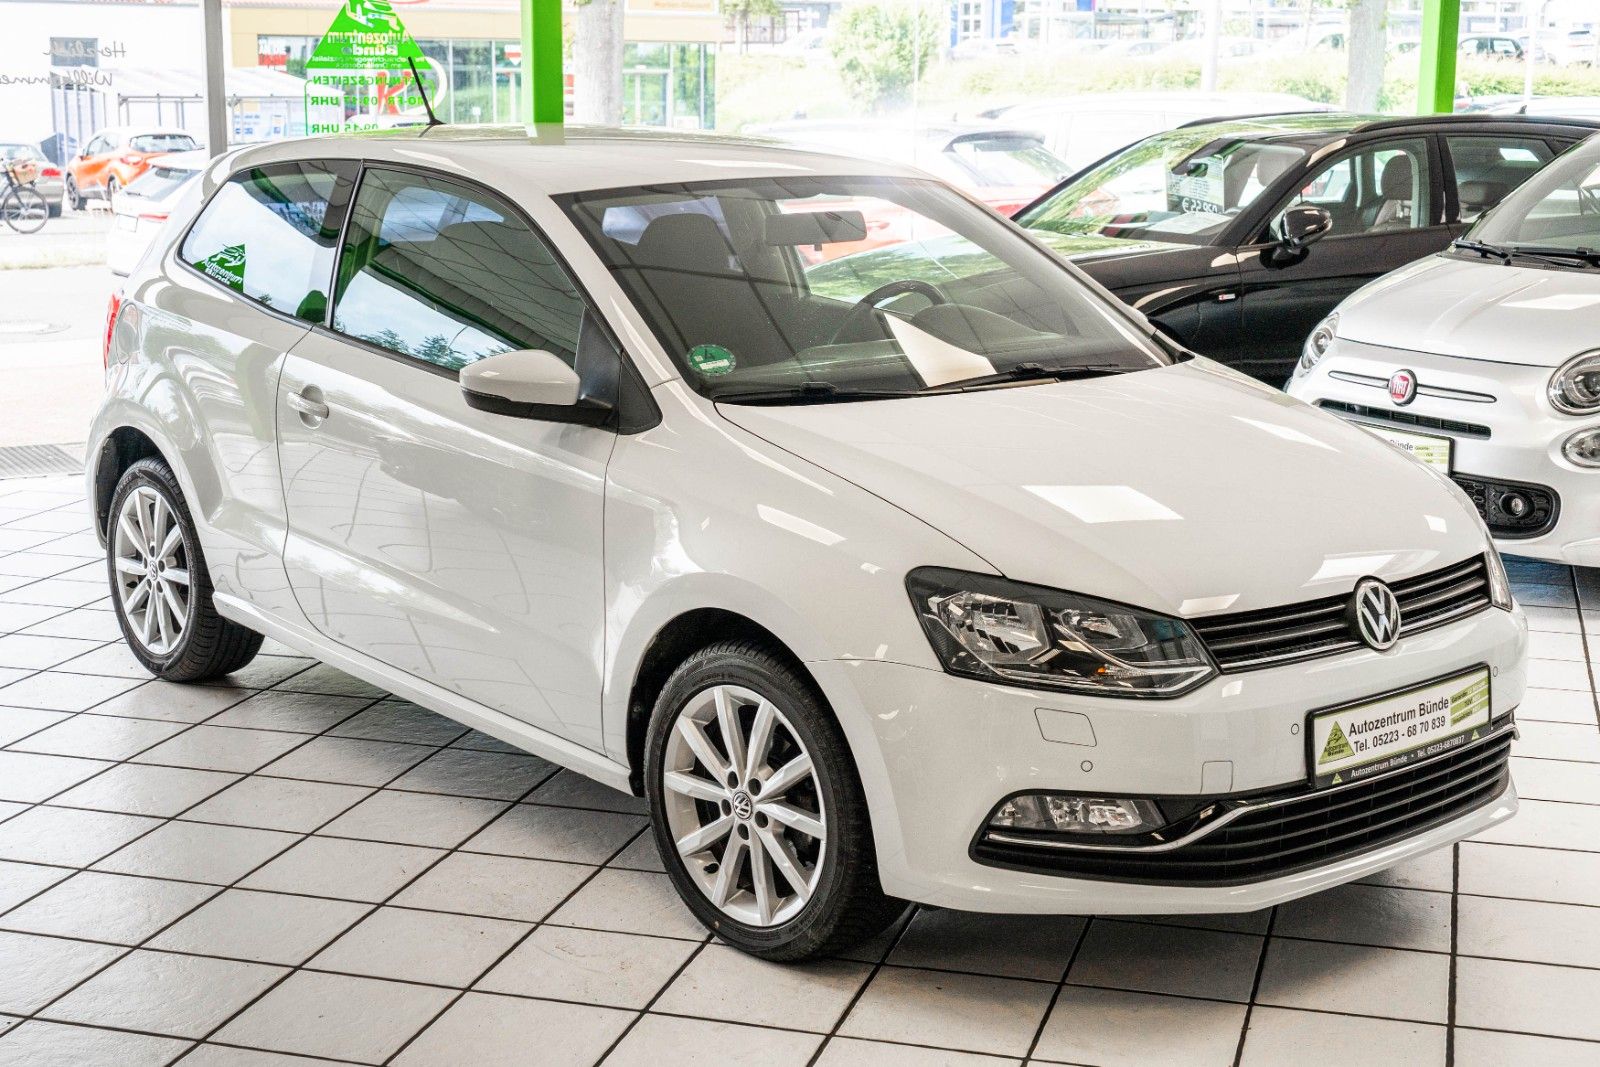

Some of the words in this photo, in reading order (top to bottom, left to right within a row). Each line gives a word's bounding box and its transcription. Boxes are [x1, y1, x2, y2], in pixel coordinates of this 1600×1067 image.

[1348, 707, 1416, 737] Autozentrum
[1419, 696, 1449, 717] Bünde
[1353, 739, 1370, 753] Tel.
[1372, 731, 1399, 748] 05223
[1407, 726, 1418, 738] 68
[1419, 721, 1430, 735] 70
[1431, 715, 1446, 730] 839
[1351, 761, 1389, 778] Autozentrum
[1389, 754, 1409, 768] Bünde
[1416, 747, 1426, 758] Tel.
